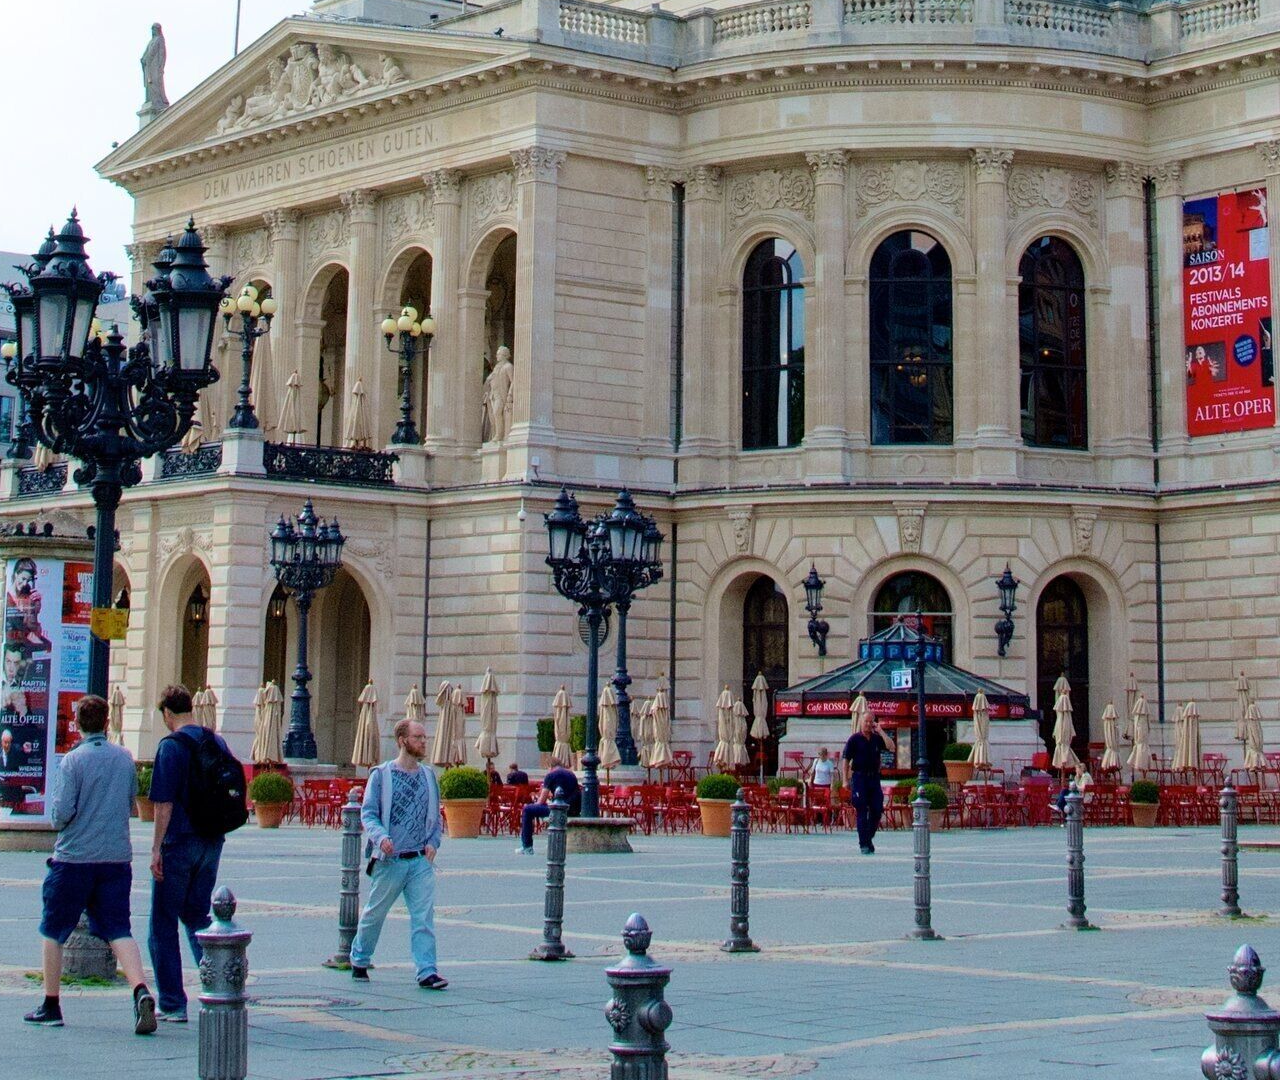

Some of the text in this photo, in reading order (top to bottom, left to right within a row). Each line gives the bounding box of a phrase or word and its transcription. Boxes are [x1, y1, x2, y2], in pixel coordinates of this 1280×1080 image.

[203, 124, 439, 200] DEM WAHREN SCHOENEN GUTEN.
[1189, 249, 1225, 265] SAISON
[1189, 261, 1245, 286] 2013/14
[1190, 287, 1241, 305] FESTIVALS
[1191, 296, 1268, 318] ABONNEMENTS
[1191, 312, 1244, 331] KONZERTE
[1195, 397, 1272, 422] ALTE OPER
[823, 703, 848, 711] ROSSO
[932, 704, 962, 712] ROSSO
[19, 714, 45, 724] OPER
